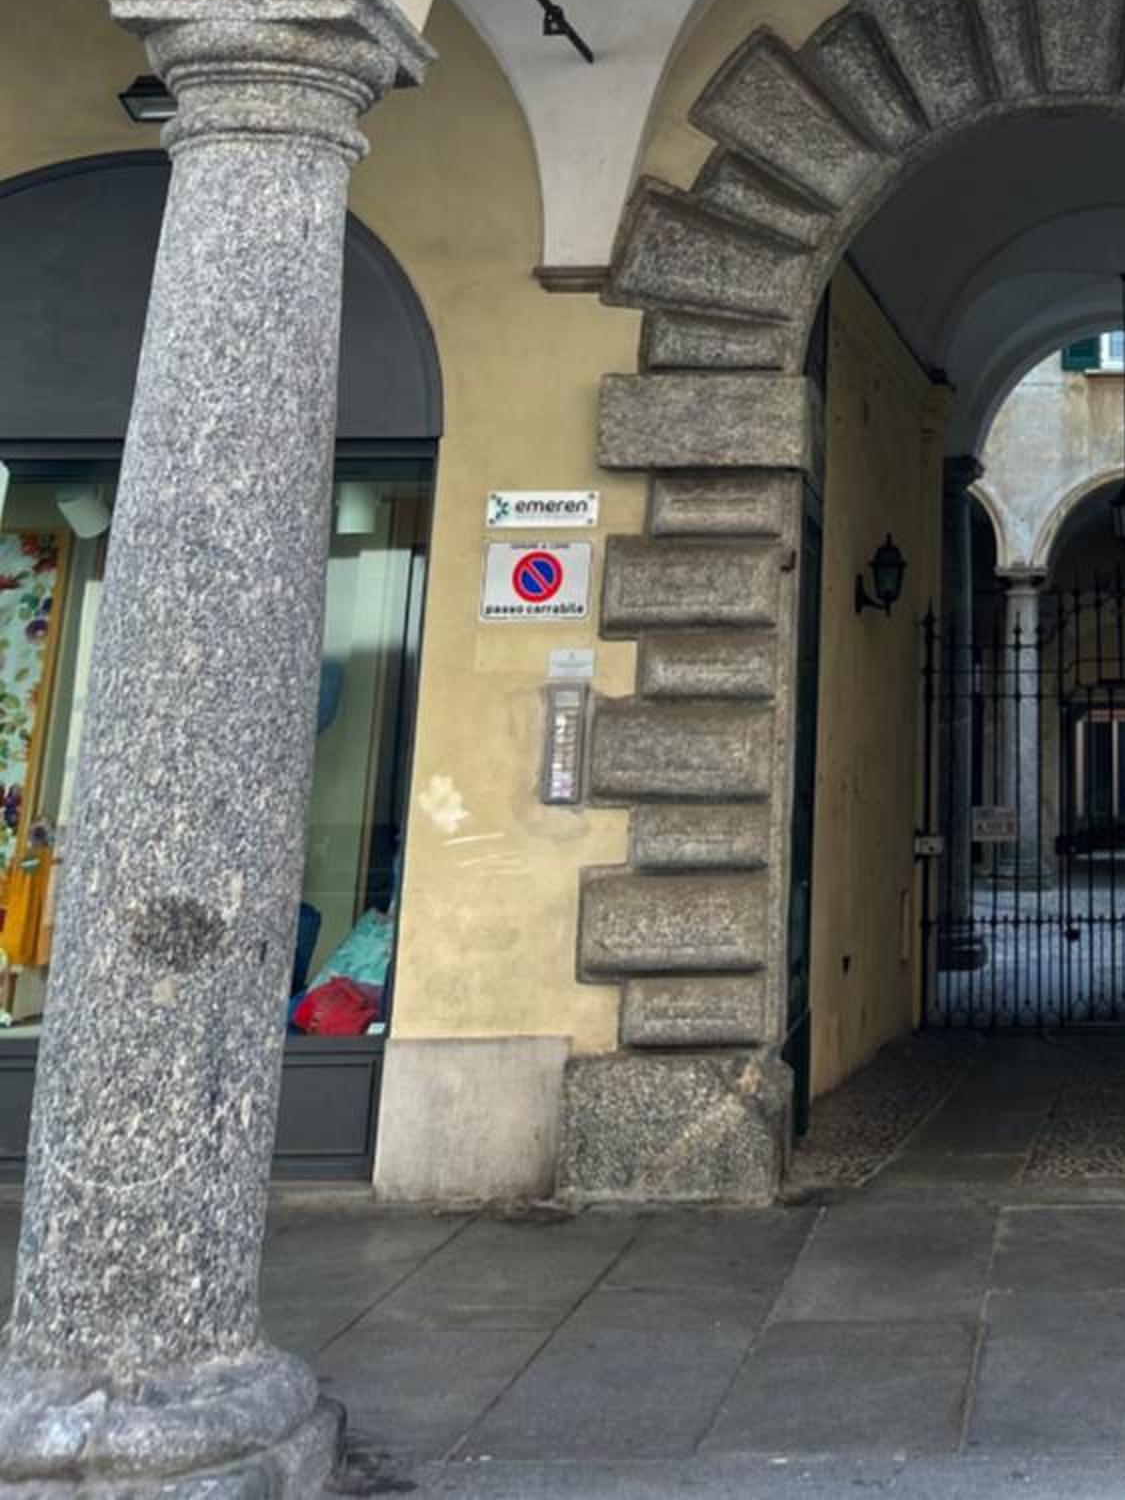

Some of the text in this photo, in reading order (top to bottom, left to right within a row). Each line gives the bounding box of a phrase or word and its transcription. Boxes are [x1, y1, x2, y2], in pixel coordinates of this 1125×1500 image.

[515, 500, 588, 513] emeren
[485, 602, 584, 614] passo carrabile
